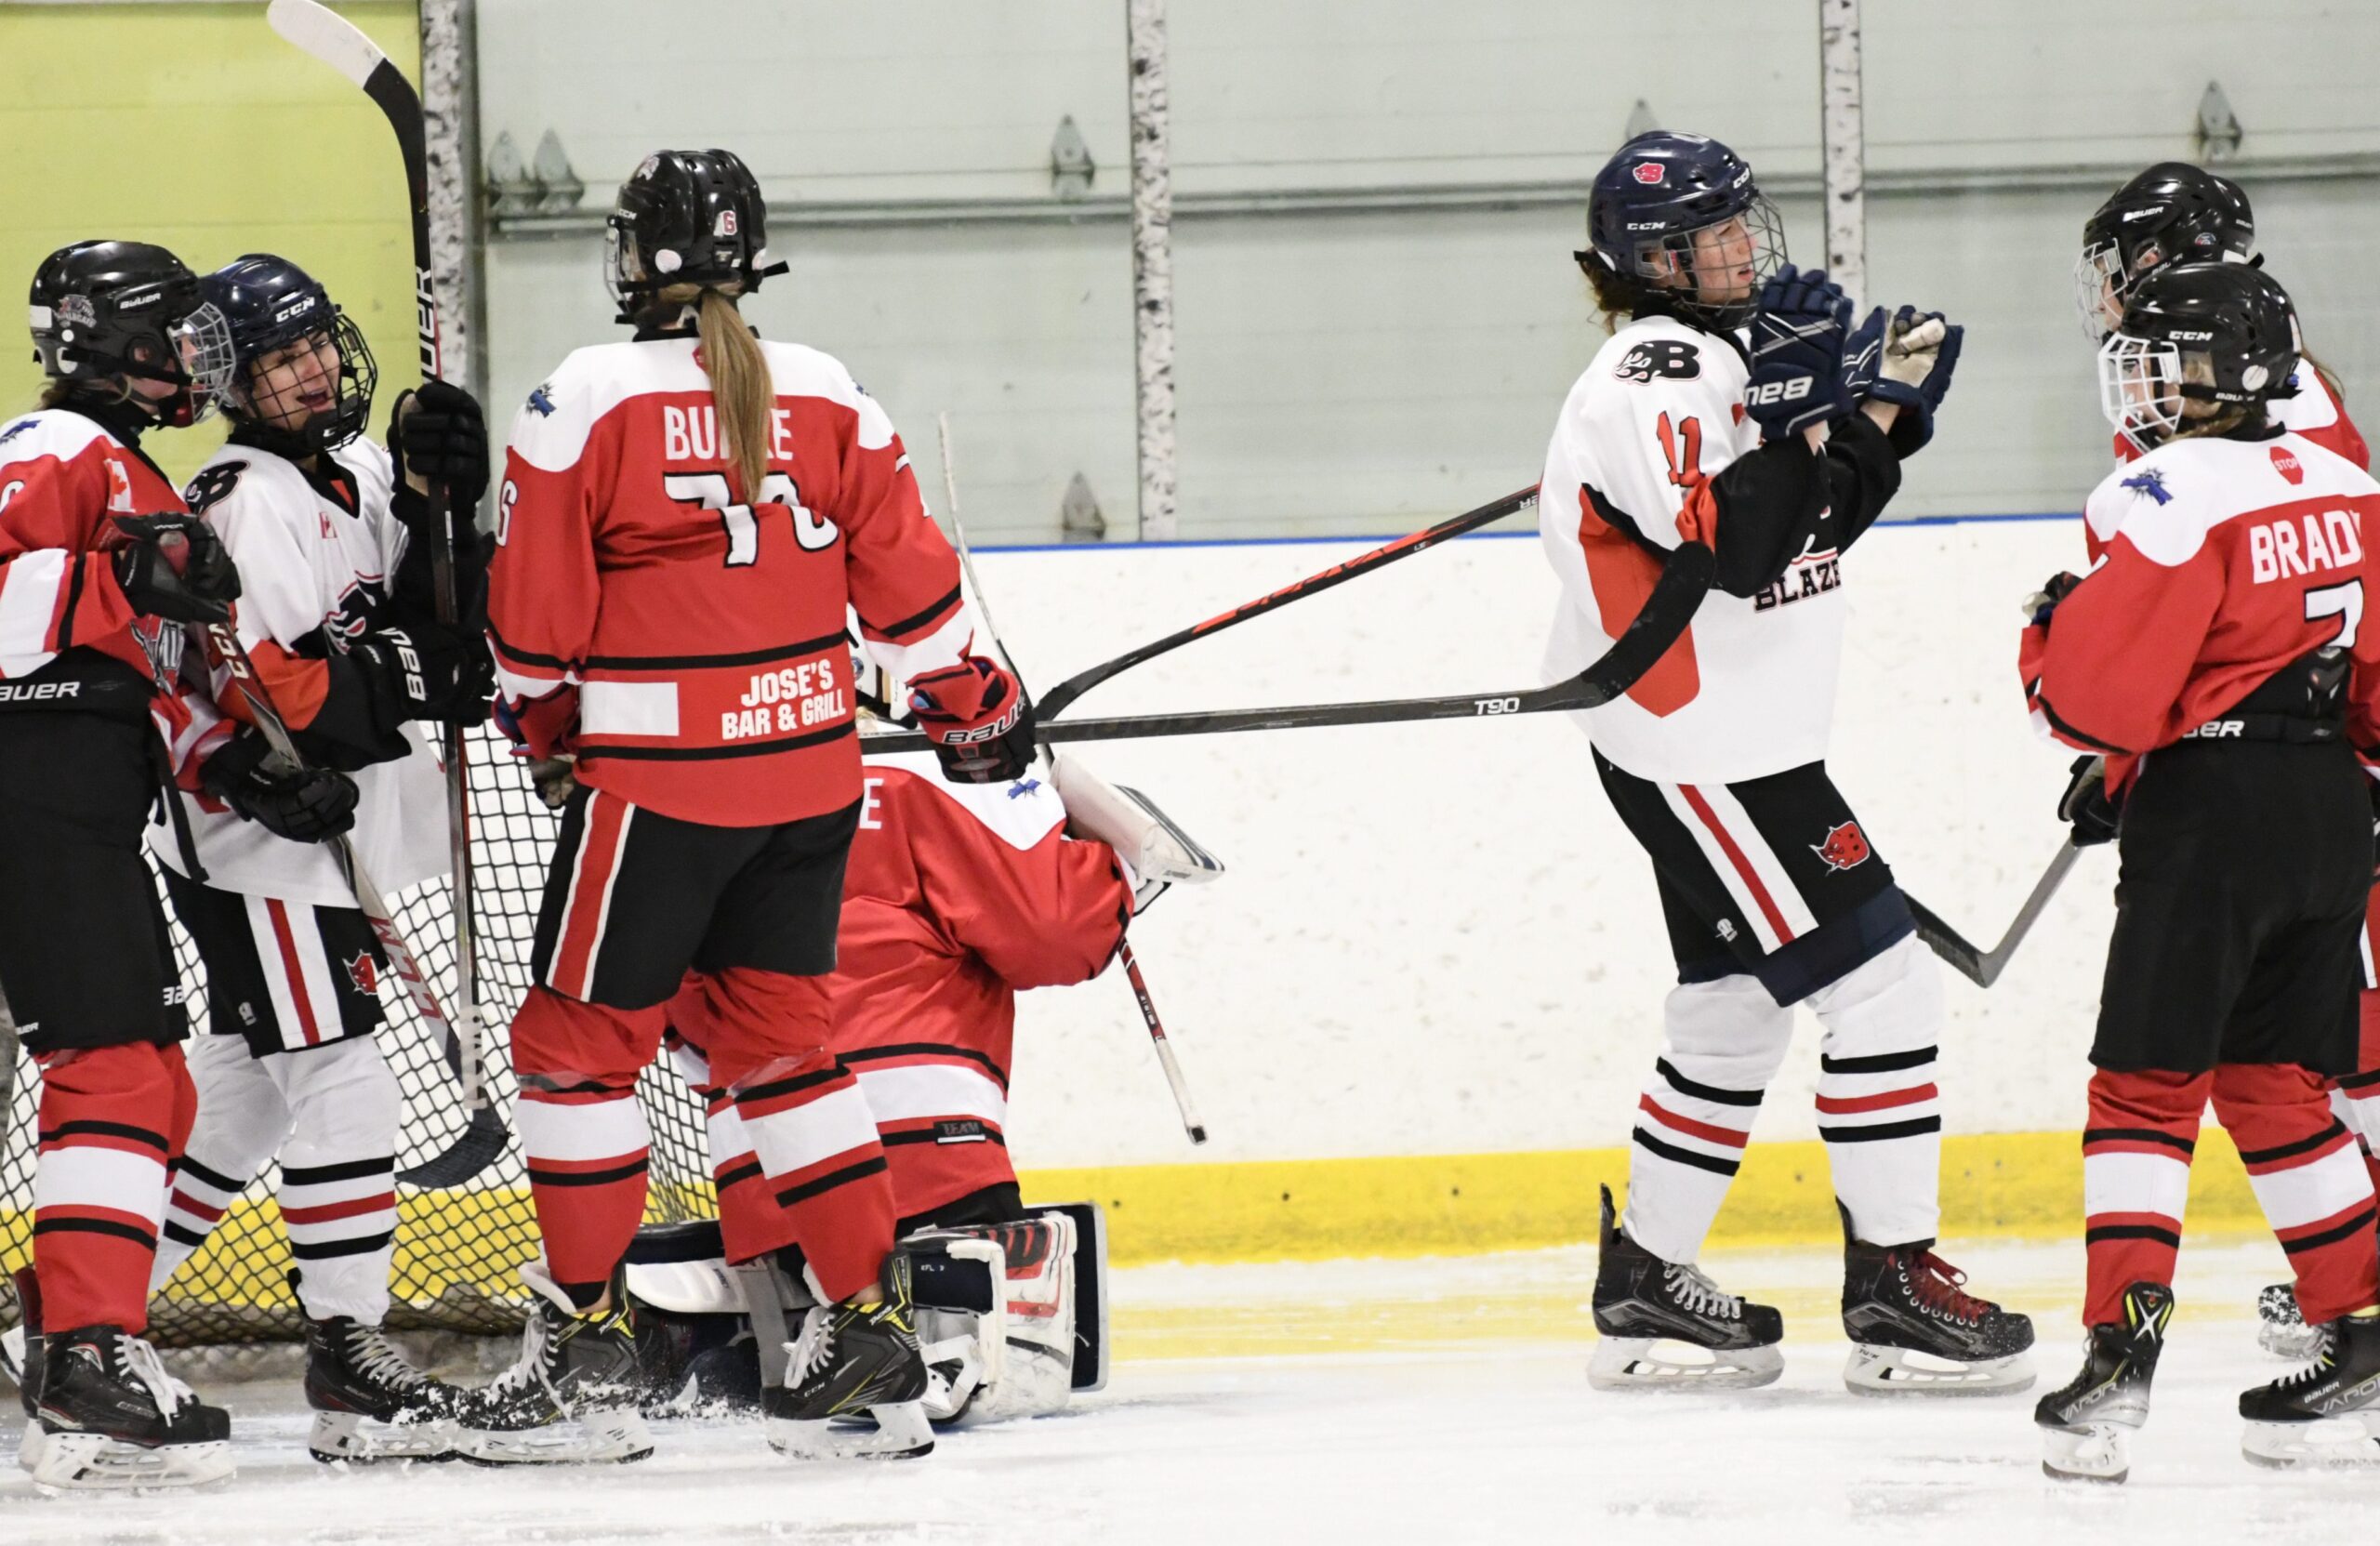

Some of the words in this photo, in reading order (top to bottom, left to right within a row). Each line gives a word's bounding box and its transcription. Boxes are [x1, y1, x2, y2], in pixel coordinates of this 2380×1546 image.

[722, 211, 737, 234] 6
[1627, 221, 1667, 231] CCM
[120, 293, 161, 310] BAUER
[276, 297, 316, 324] CCM
[416, 265, 438, 377] UER
[2169, 330, 2214, 341] CCM
[1745, 375, 1814, 407] BAU
[663, 405, 793, 461] BUE
[1656, 409, 1706, 487] 11
[2250, 509, 2366, 585] BRAD
[0, 681, 81, 702] AUER
[740, 658, 835, 707] JOSE'S
[721, 707, 772, 741] BAR
[777, 703, 798, 732] &
[800, 688, 847, 726] GRILL
[1474, 697, 1520, 715] T90
[804, 1381, 826, 1398] CCM
[2304, 1380, 2341, 1404] BAUER
